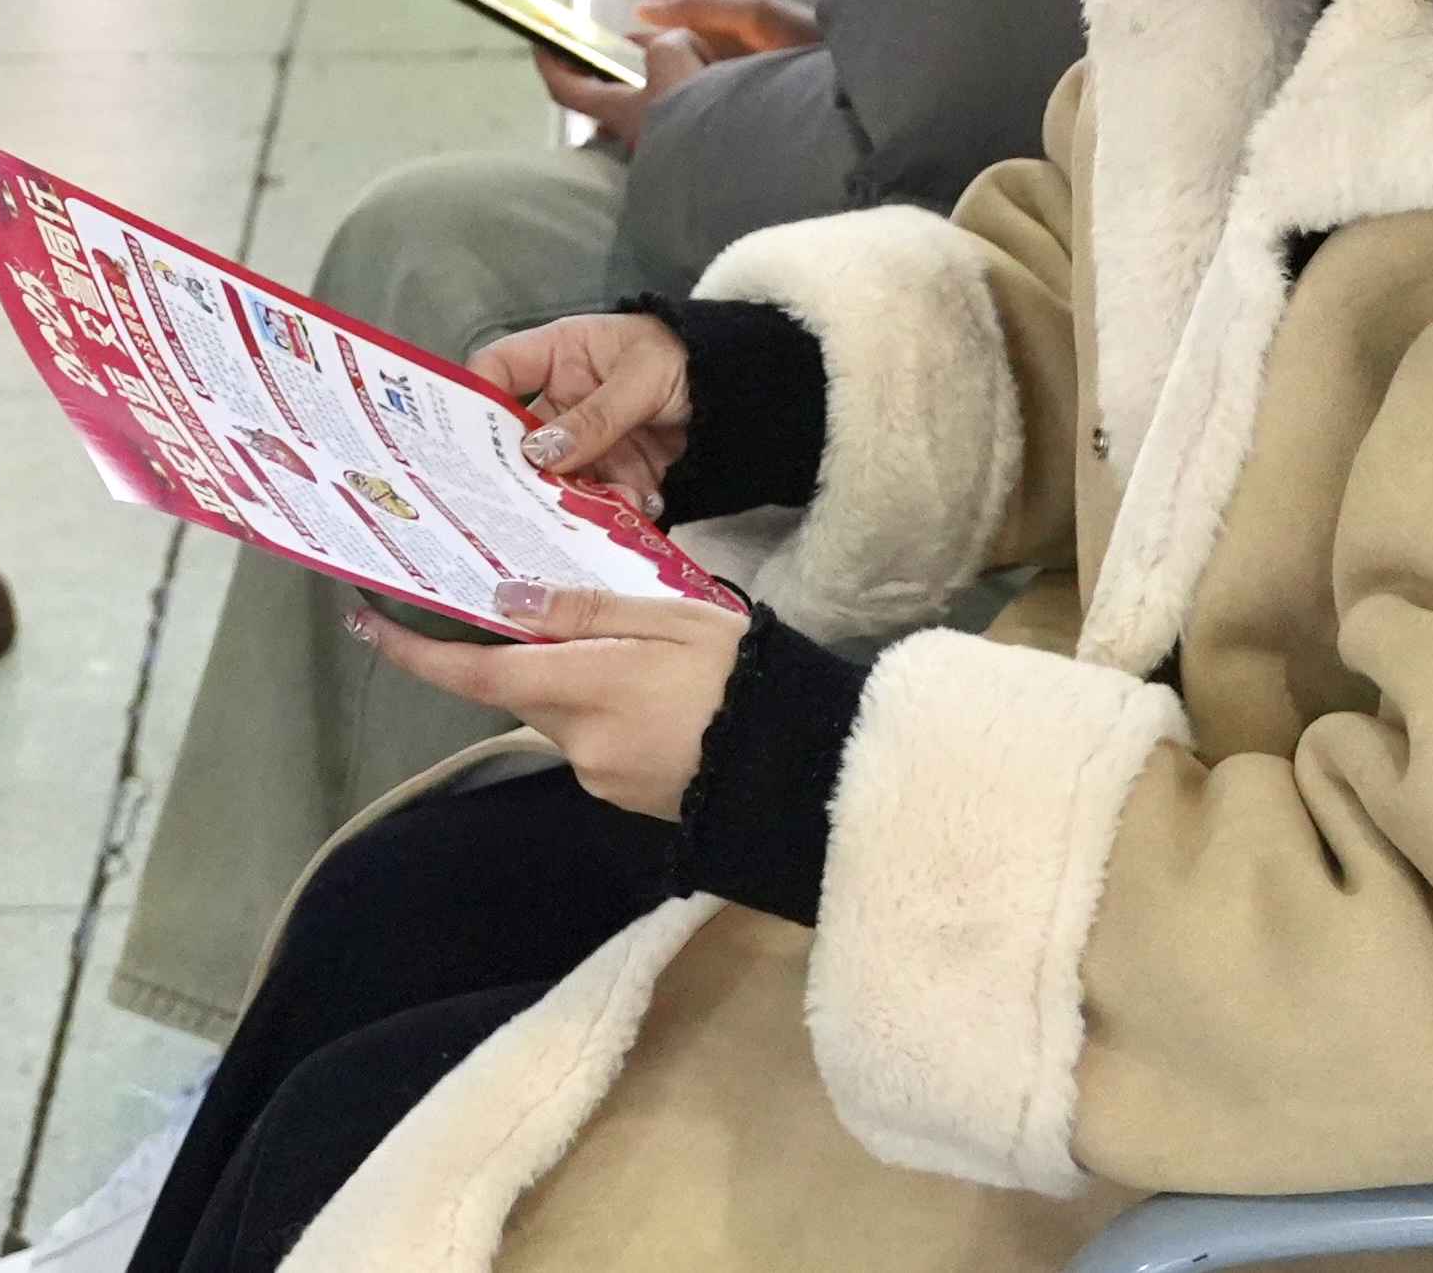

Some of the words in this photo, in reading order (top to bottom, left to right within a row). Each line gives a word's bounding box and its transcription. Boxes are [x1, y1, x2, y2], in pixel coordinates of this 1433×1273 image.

[4, 260, 109, 398] 2025
[16, 174, 131, 357] 交警同行
[101, 363, 242, 523] 平安春运
